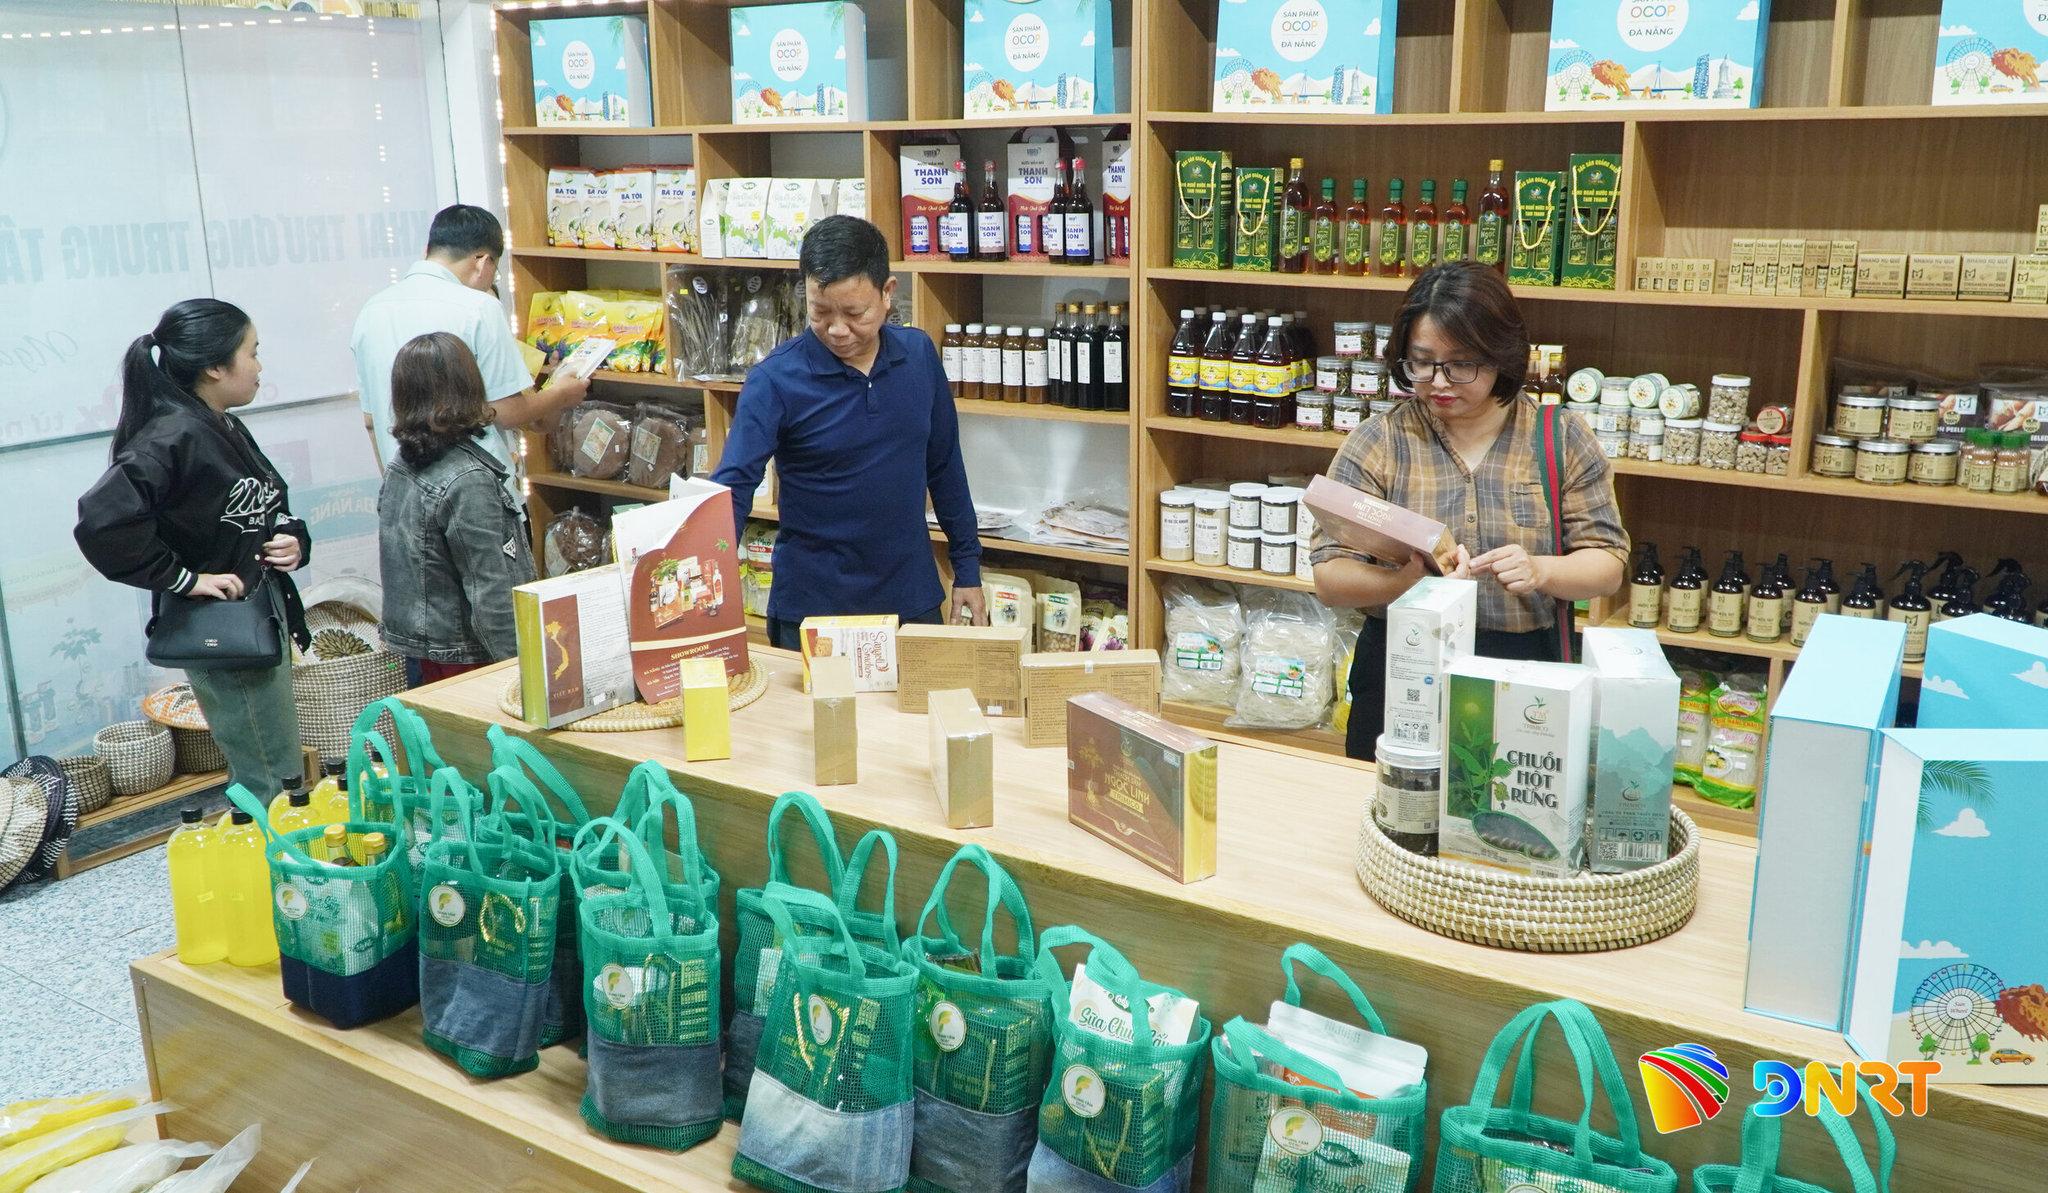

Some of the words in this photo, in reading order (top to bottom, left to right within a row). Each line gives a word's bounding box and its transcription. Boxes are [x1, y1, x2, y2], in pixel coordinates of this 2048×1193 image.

[1630, 5, 1676, 18] OCOP
[1282, 20, 1318, 32] OCOP
[1012, 34, 1040, 46] OCOP
[777, 49, 801, 59] OCOP
[914, 167, 949, 176] THANH
[1018, 167, 1048, 176] THANH
[1107, 165, 1126, 174] THANH
[670, 644, 709, 660] SHOWROOM
[1506, 750, 1563, 773] CHUỐI
[1516, 769, 1555, 790] HỘT
[1104, 774, 1129, 795] NGỌC
[1129, 781, 1150, 806] LINH
[1510, 787, 1559, 809] RỪNG
